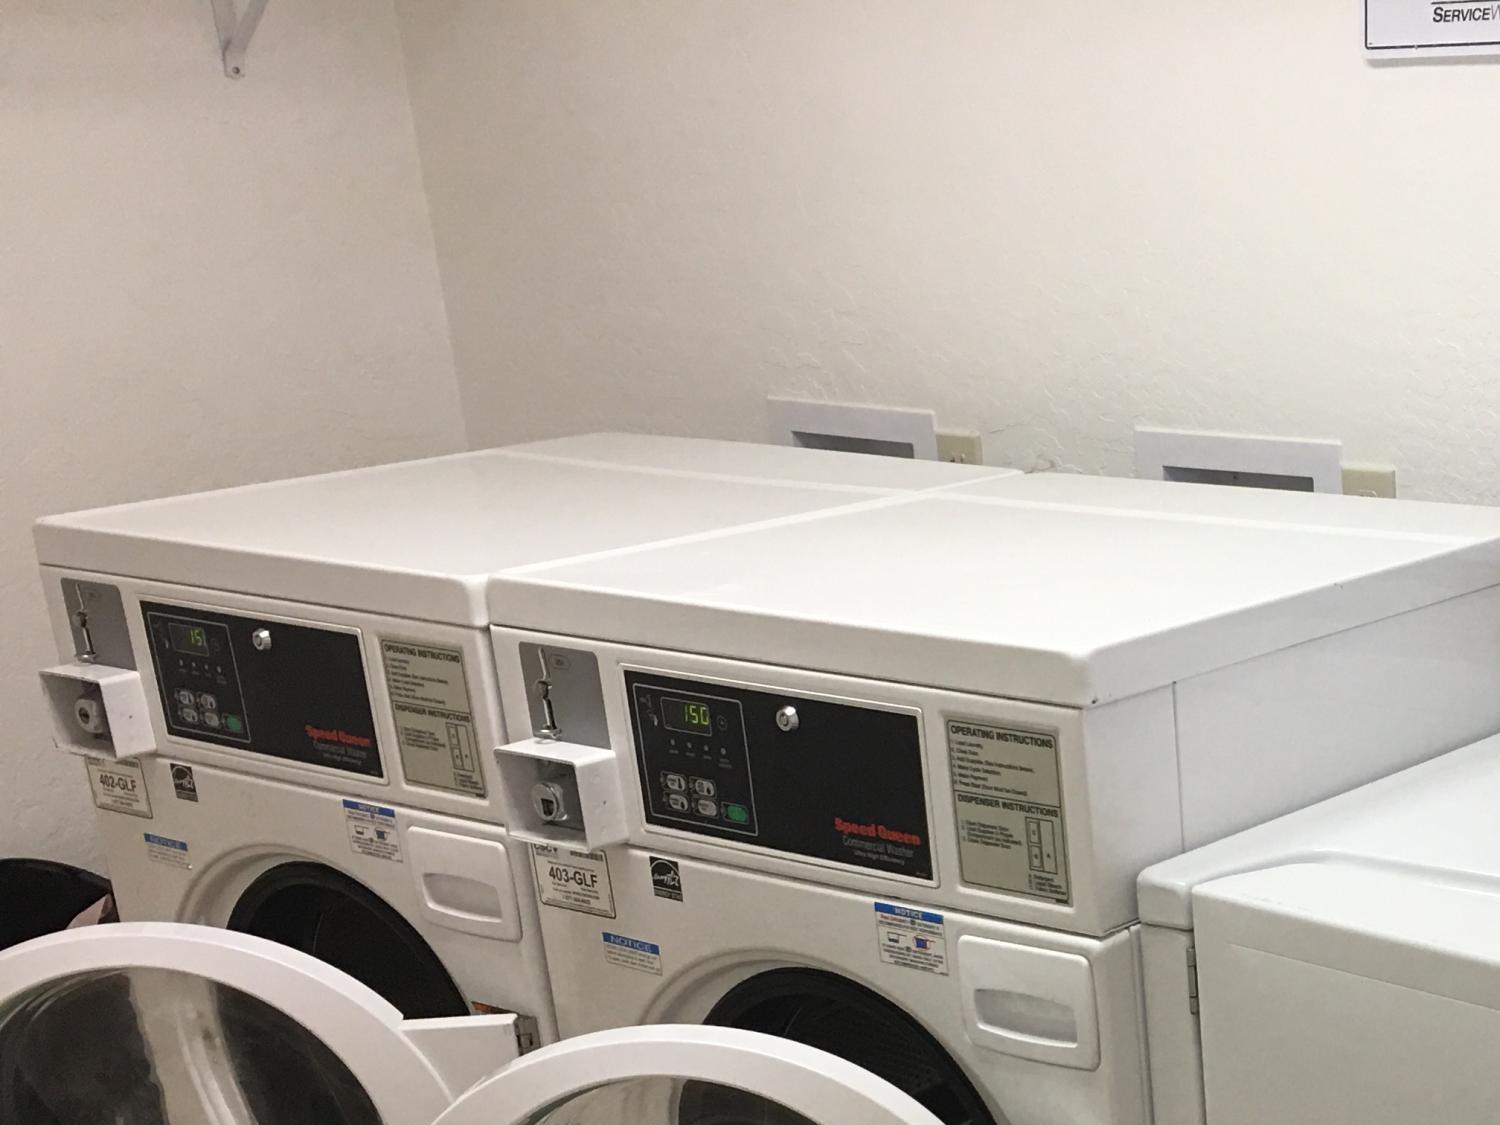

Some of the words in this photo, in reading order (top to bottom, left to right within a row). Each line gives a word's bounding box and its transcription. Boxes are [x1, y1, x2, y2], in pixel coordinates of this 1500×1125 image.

[685, 704, 710, 725] 150
[950, 724, 994, 741] OPERATING
[996, 731, 1053, 749] INSTRUCTIONS
[957, 793, 1001, 809] DISPENSER
[1001, 801, 1059, 818] INSTRUCTIONS
[834, 816, 877, 836] Speed
[877, 824, 921, 846] Queen
[548, 866, 598, 888] 403-GLF
[610, 935, 652, 951] NOTICE
